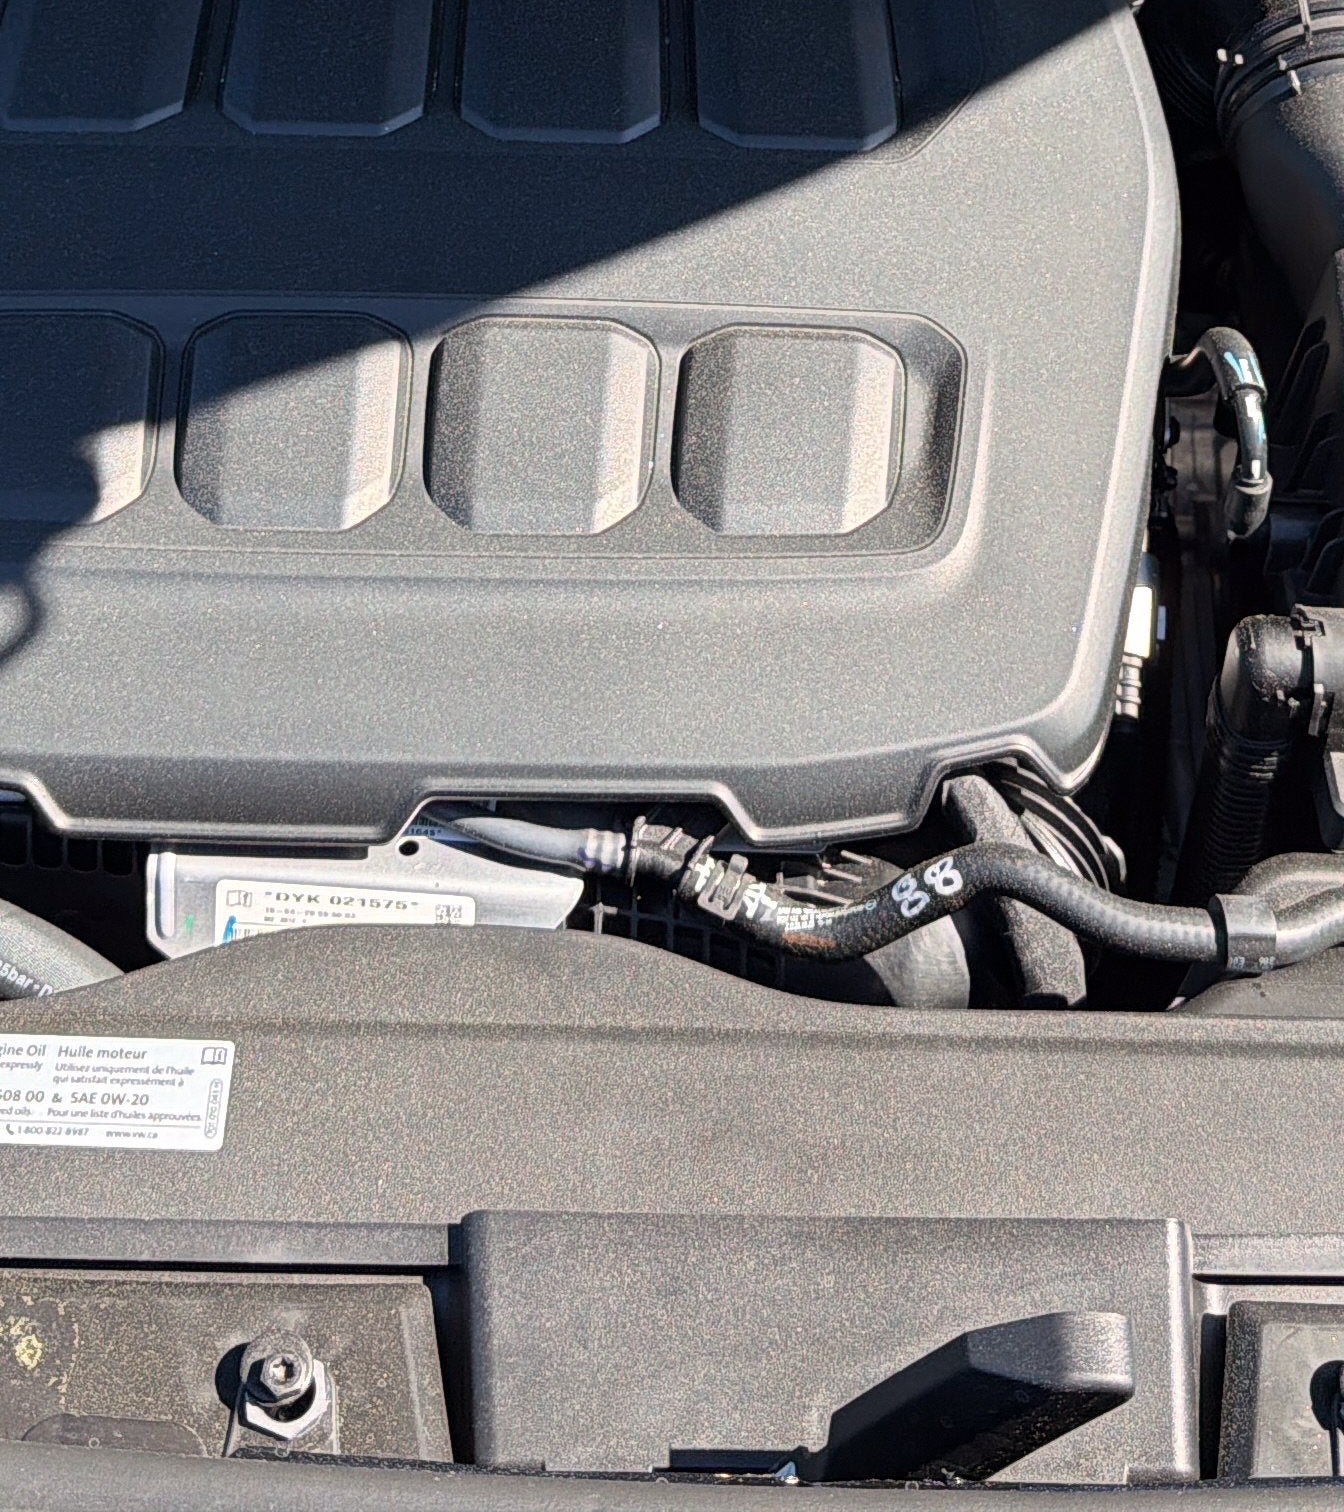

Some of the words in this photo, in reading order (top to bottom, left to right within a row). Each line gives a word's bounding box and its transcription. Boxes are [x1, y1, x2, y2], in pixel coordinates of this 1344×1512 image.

[26, 1044, 47, 1057] Oil
[57, 1045, 94, 1059] Huile
[96, 1048, 148, 1060] moteur
[25, 1090, 45, 1103] 00
[51, 1092, 63, 1103] &
[70, 1091, 97, 1104] SAE
